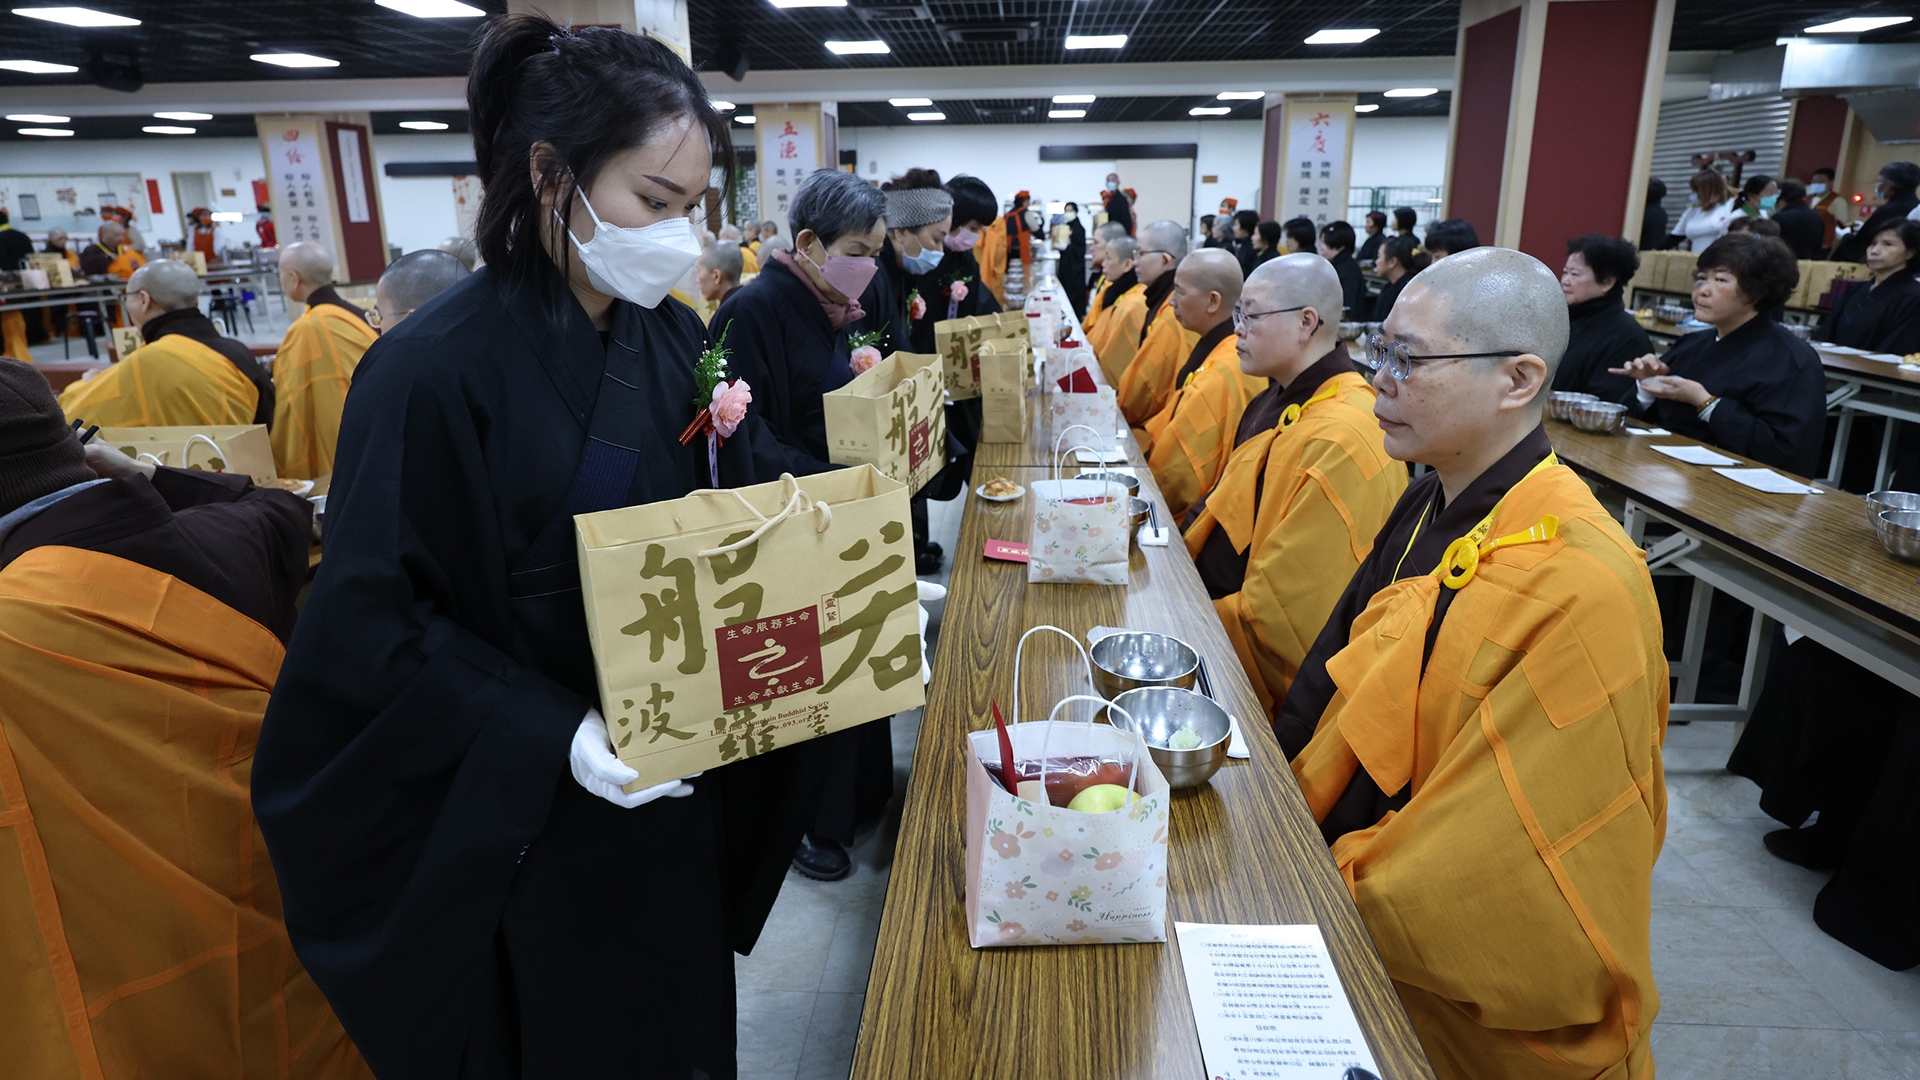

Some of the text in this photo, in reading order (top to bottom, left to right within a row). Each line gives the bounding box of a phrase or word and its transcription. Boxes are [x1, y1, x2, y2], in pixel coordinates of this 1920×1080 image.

[726, 611, 810, 640] 生命服務生命
[734, 676, 816, 706] 生命奉獻生命
[744, 715, 777, 729] Mountain
[778, 707, 807, 720] Buddhist
[808, 700, 830, 711] Society
